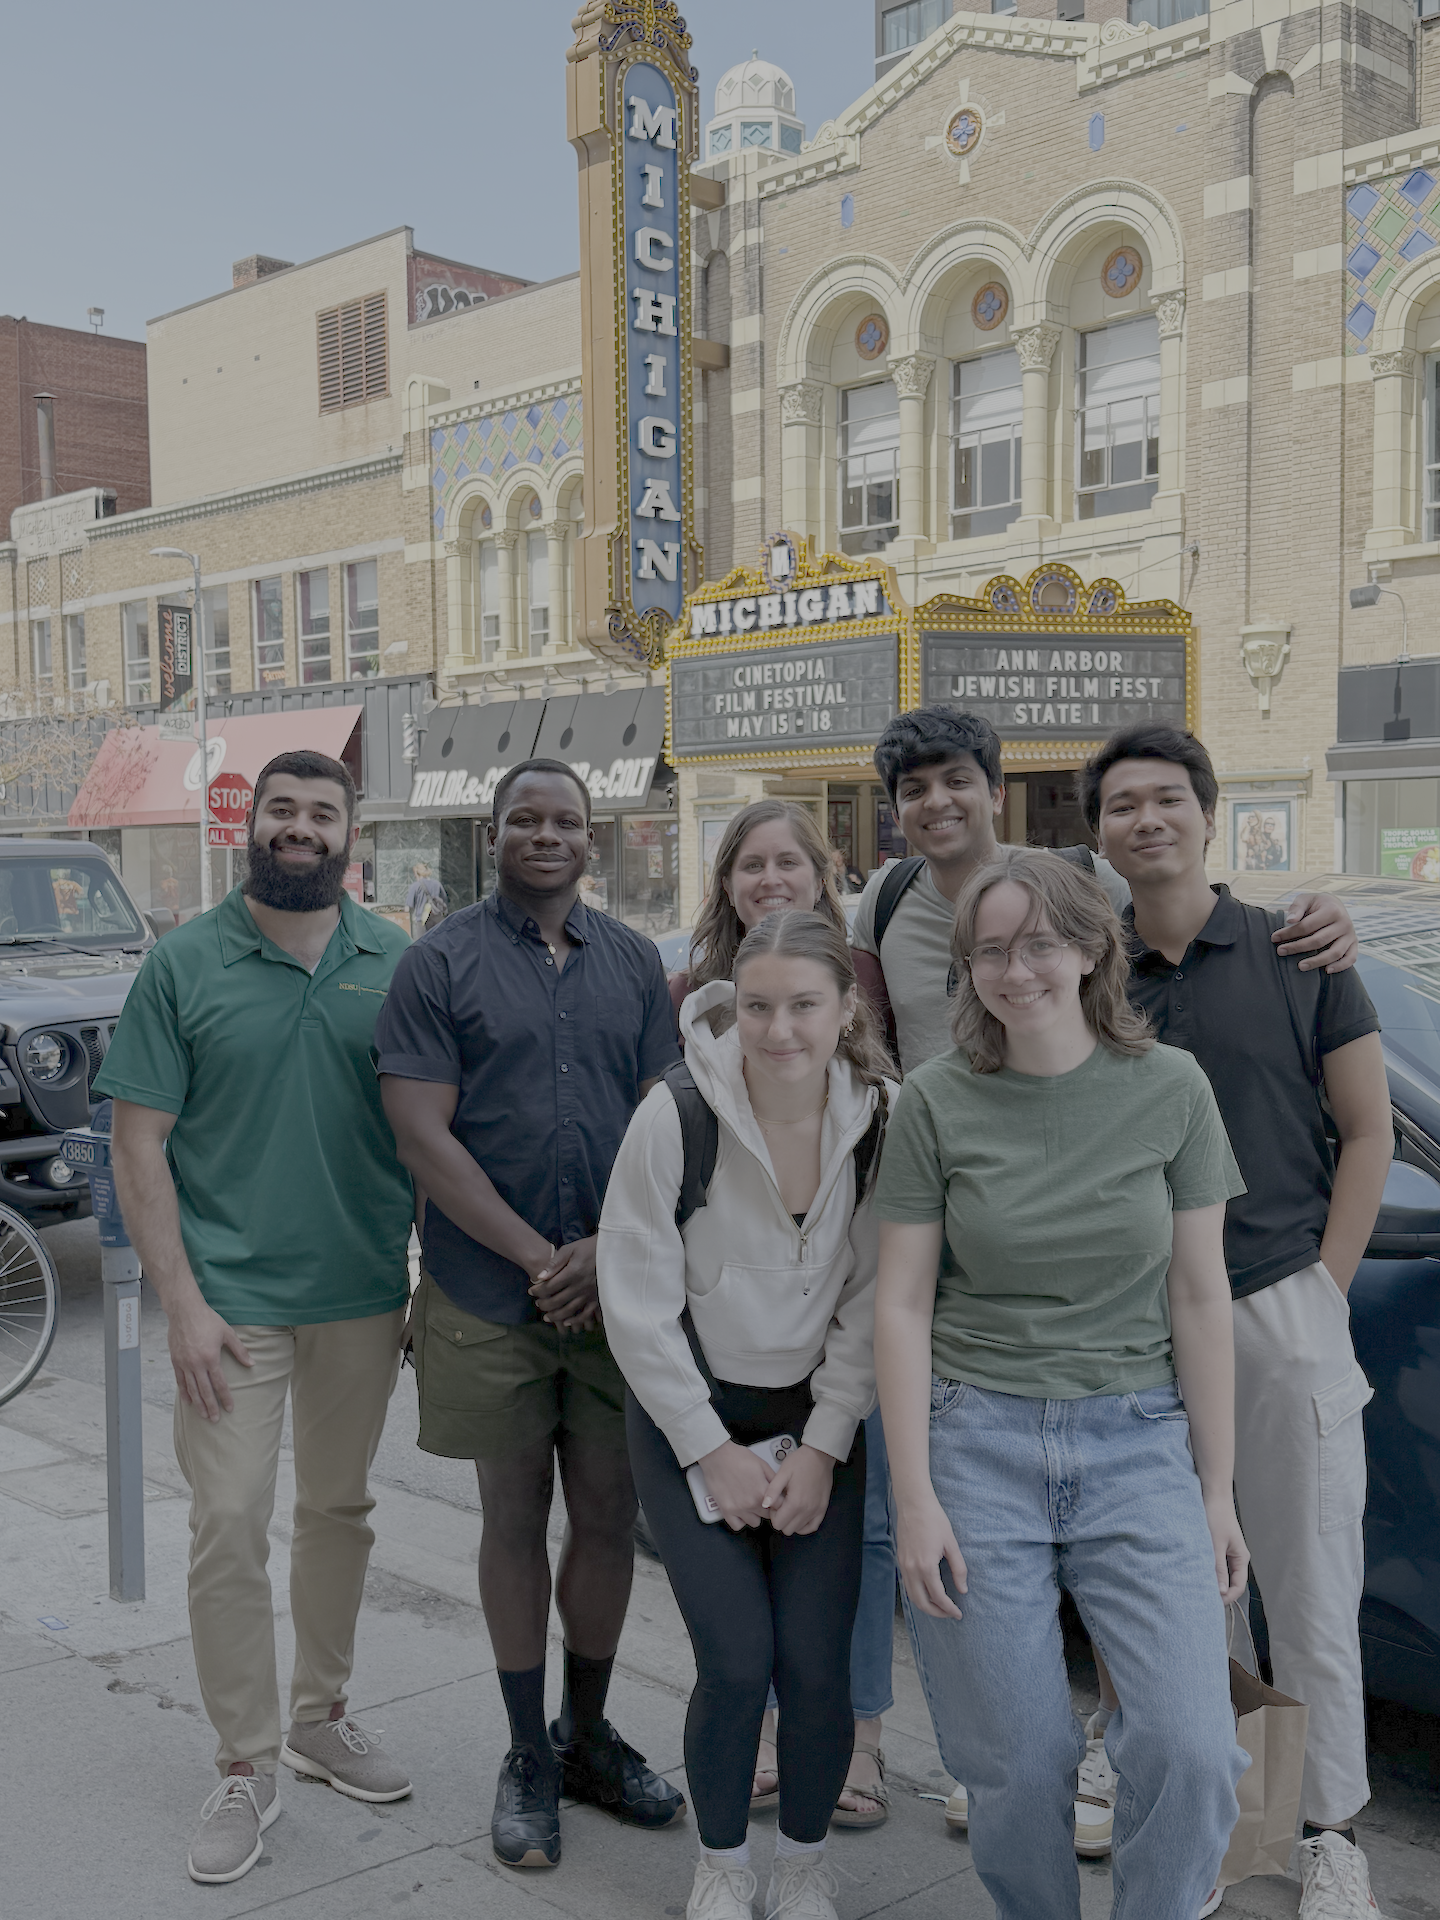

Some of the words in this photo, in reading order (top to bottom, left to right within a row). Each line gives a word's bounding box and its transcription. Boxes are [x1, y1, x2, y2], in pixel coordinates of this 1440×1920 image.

[627, 95, 681, 582] MICHIGAN
[771, 546, 790, 578] M
[690, 581, 880, 635] MICHIGAN
[160, 608, 175, 699] welcome
[177, 615, 187, 674] DISTRICT
[733, 658, 826, 687] CINETOPIA
[996, 650, 1040, 671] ANN
[1049, 650, 1123, 672] ARBOR
[714, 691, 756, 715] FILM
[763, 682, 847, 709] FESTIVAL
[952, 675, 1036, 698] JEWISH
[1046, 676, 1099, 698] FILM
[1108, 677, 1162, 698] FEST
[727, 716, 763, 738] MAY
[770, 713, 789, 735] 15
[812, 709, 831, 732] 18
[1014, 702, 1082, 725] STATE
[210, 787, 252, 810] STOP
[209, 830, 228, 844] ALL
[234, 830, 249, 844] WA
[338, 982, 358, 991] NDSU
[67, 1141, 95, 1163] 3850
